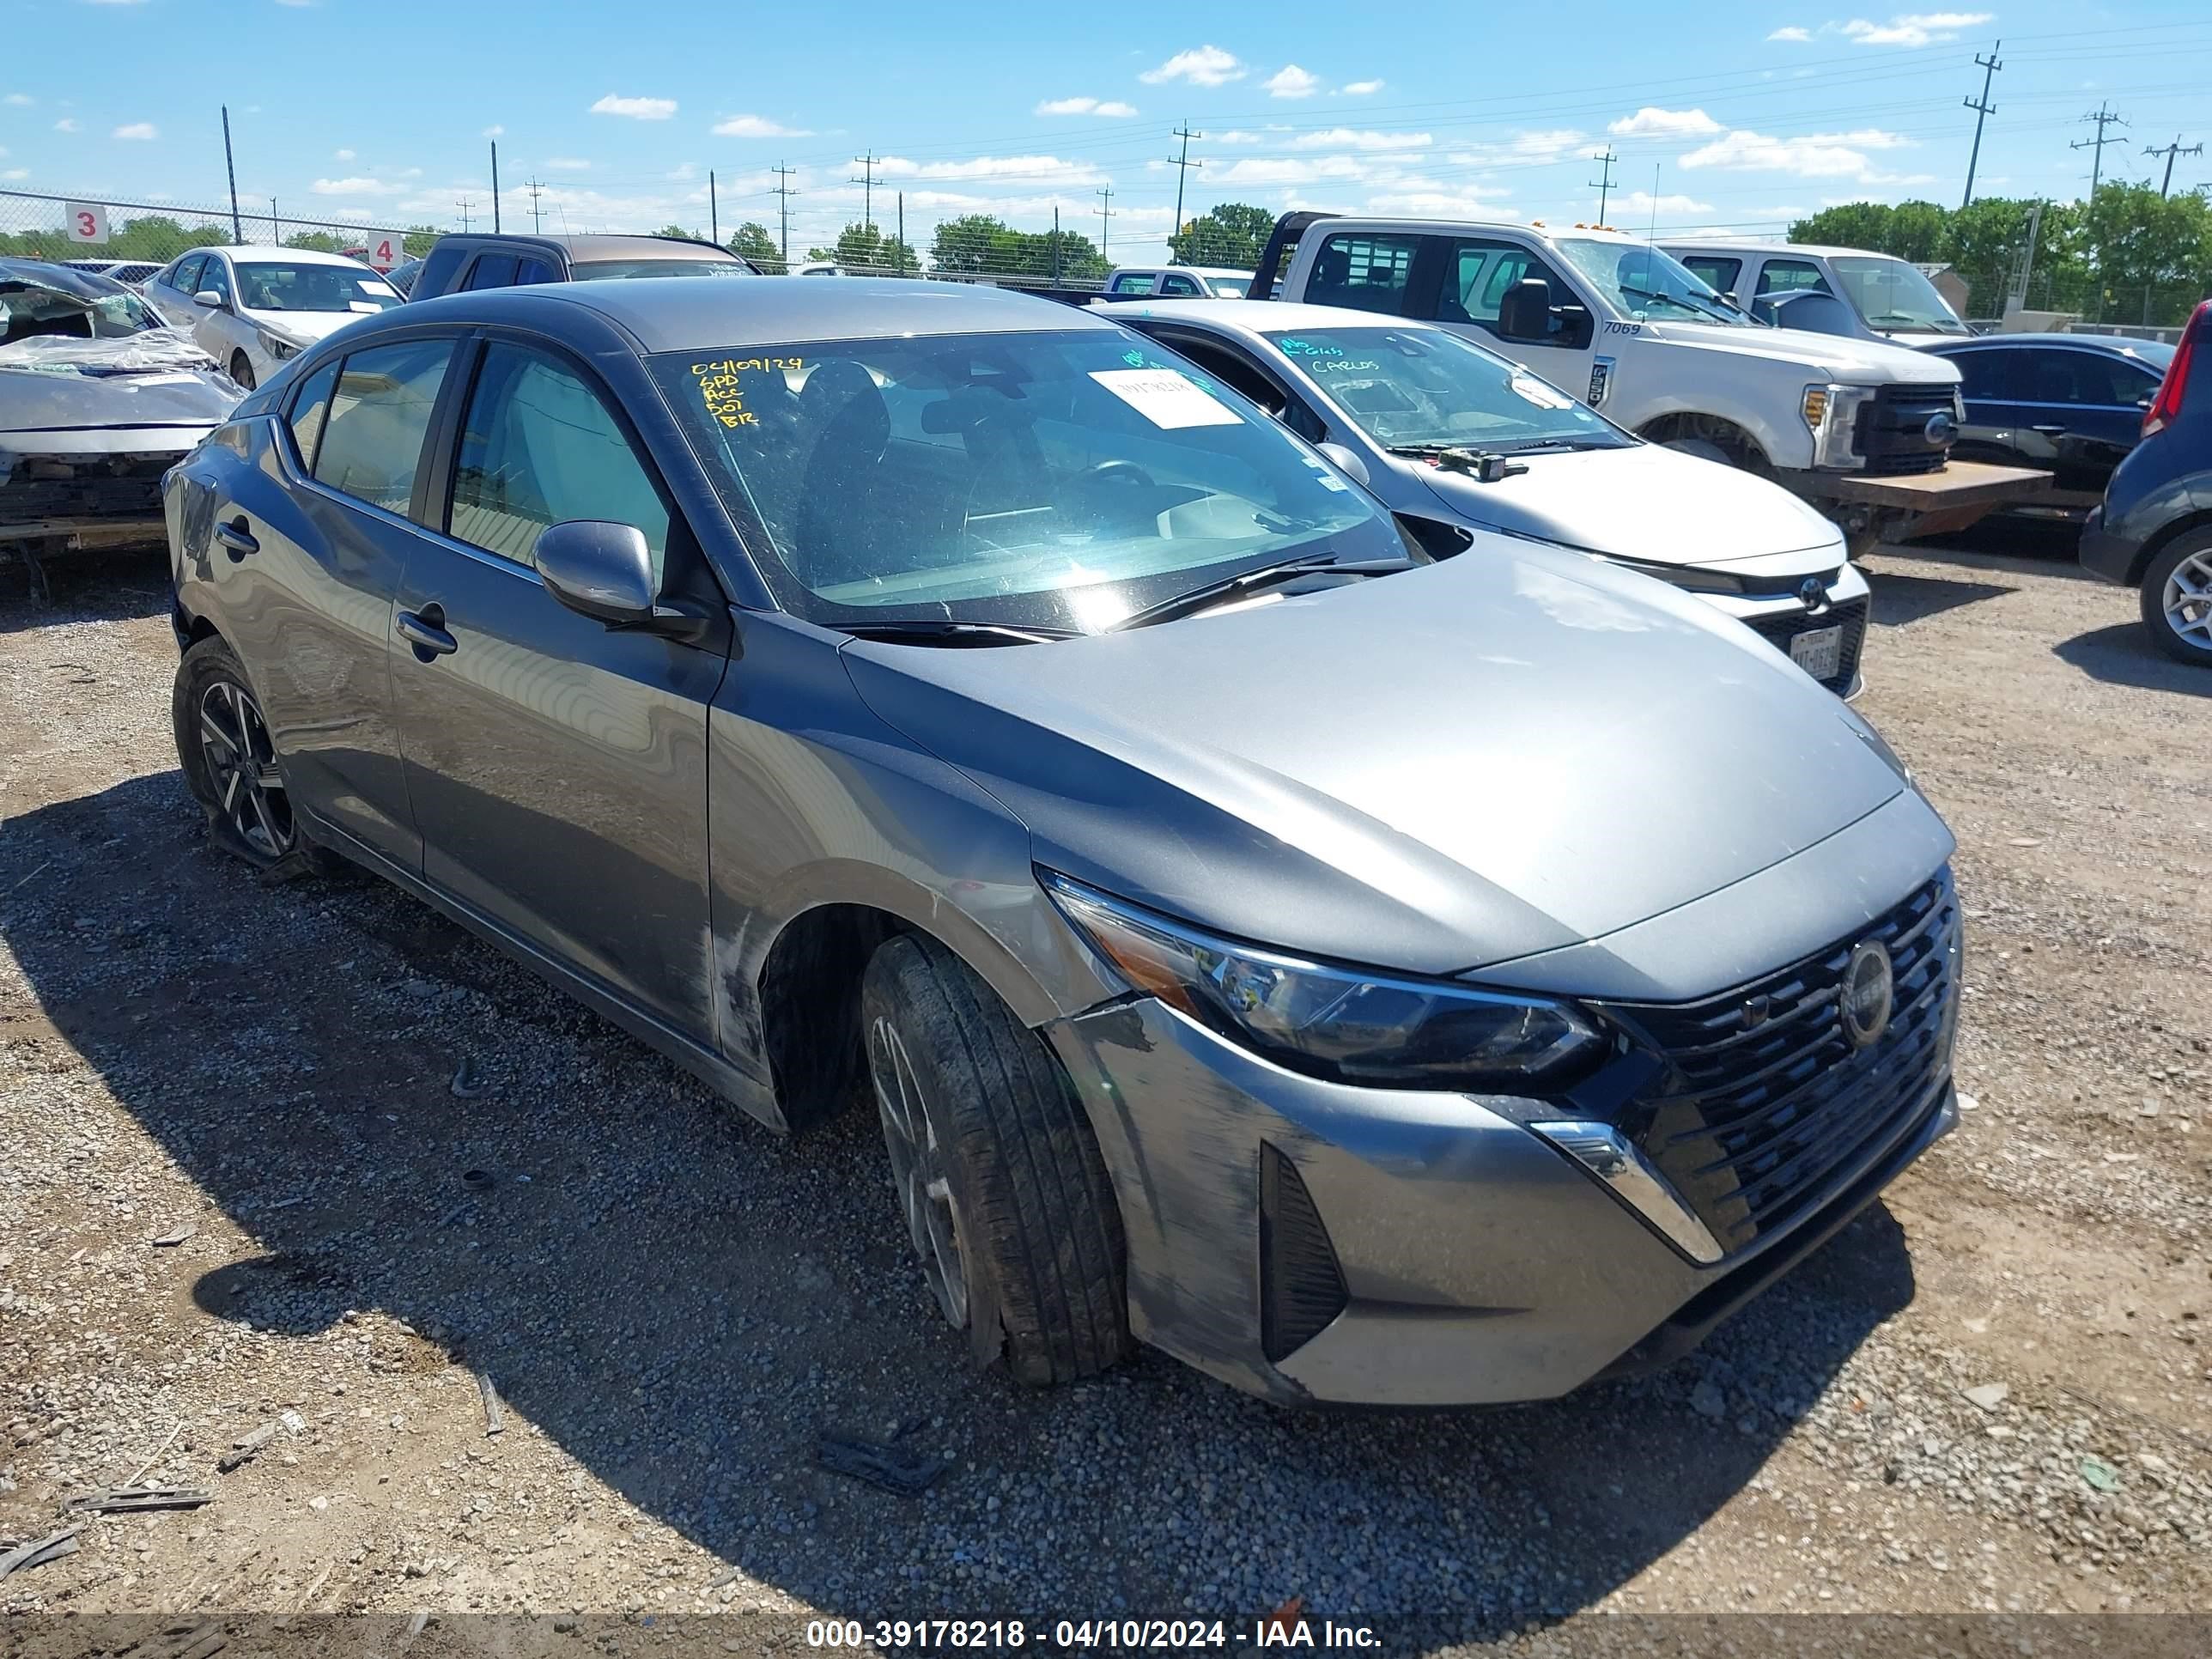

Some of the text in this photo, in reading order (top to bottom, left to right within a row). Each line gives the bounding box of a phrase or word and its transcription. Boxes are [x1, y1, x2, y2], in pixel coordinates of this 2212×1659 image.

[76, 211, 96, 238] 3
[375, 240, 394, 263] 4
[1604, 321, 1641, 335] 7069
[691, 358, 802, 374] 04/09/24
